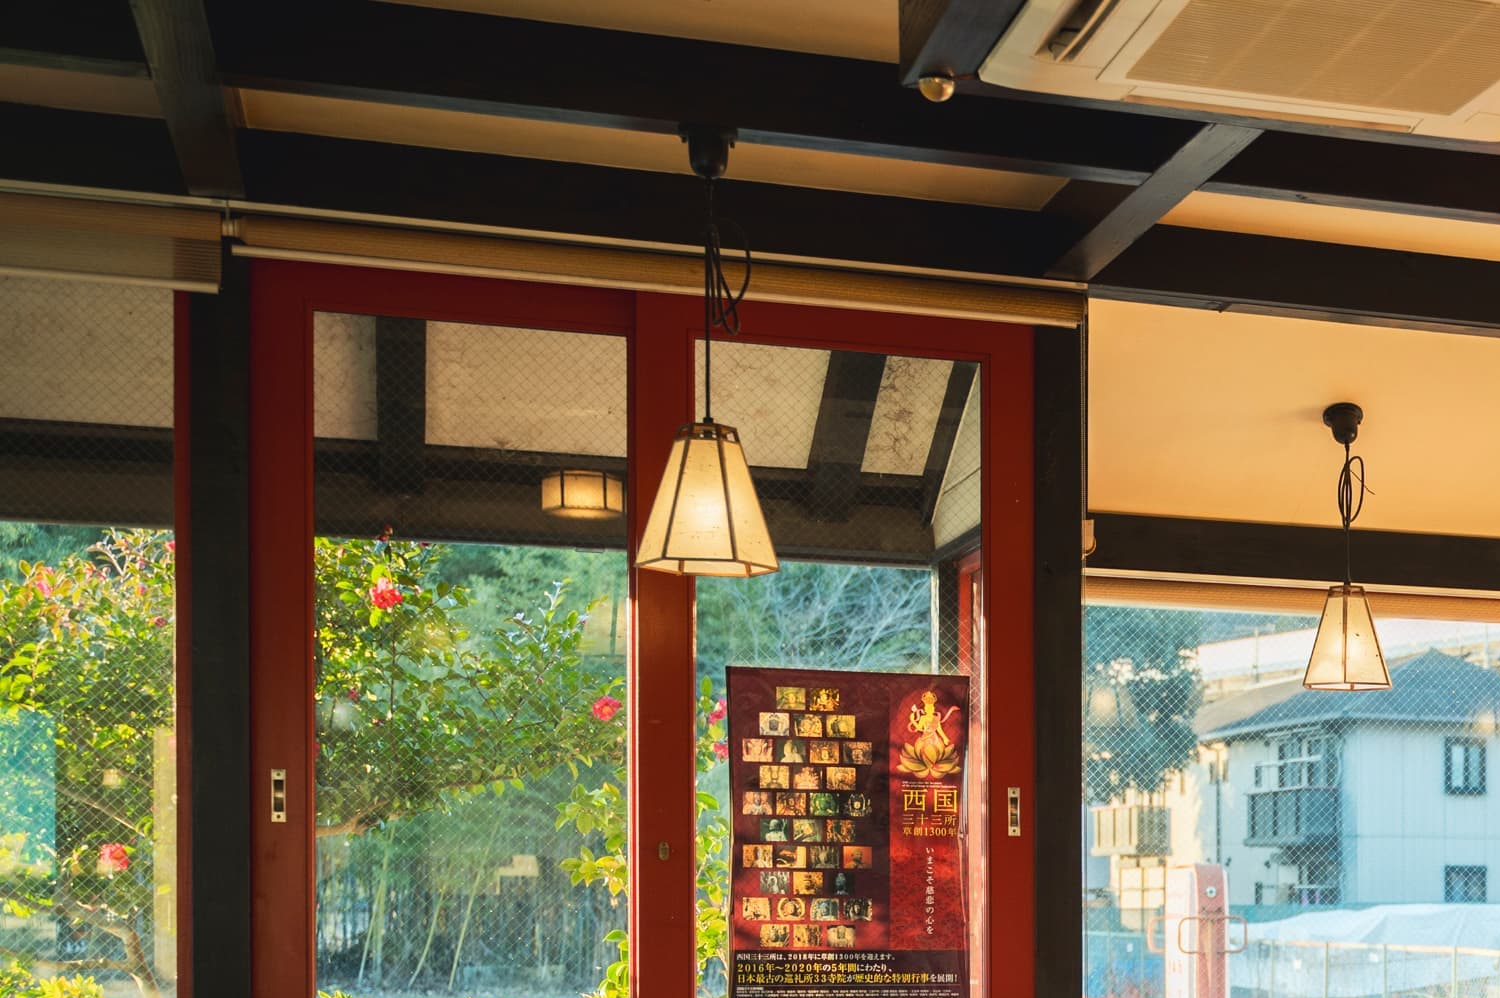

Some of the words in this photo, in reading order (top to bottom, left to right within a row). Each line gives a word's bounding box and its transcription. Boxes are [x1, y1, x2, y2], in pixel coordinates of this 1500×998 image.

[902, 789, 958, 813] 西国
[902, 814, 957, 826] 三十三所
[903, 826, 957, 837] 草創1300年
[925, 847, 935, 935] いまこそ慈悲の心を
